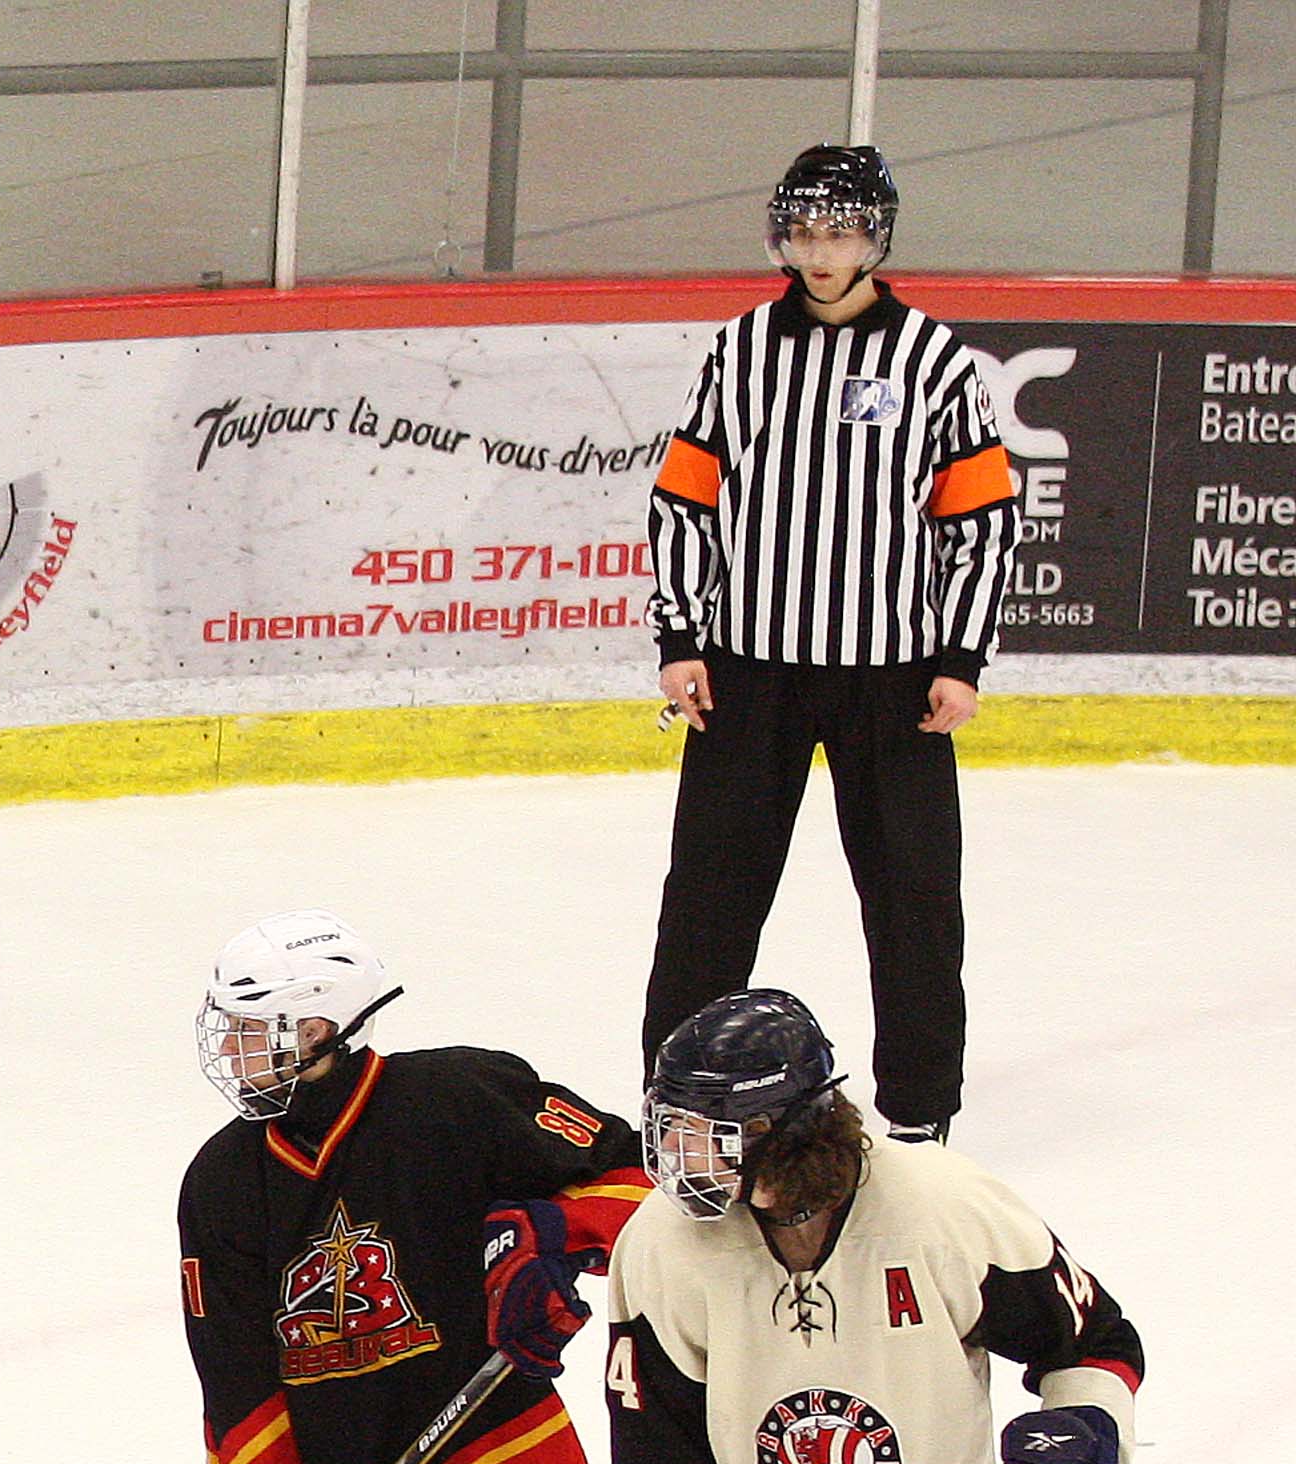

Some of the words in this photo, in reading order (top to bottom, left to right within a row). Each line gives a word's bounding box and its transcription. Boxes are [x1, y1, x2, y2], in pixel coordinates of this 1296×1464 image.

[194, 396, 339, 471] Toujours
[348, 397, 380, 438] là
[381, 416, 471, 454] pour
[480, 437, 550, 471] vous
[560, 430, 671, 476] diverti
[1196, 484, 1296, 525] Fibre
[352, 547, 453, 585] 450
[471, 543, 655, 582] 371-100
[202, 596, 646, 644] cinema7valleyfield.
[1000, 602, 1095, 626] 65-5663
[285, 932, 341, 951] EASTON
[534, 1096, 602, 1148] 81
[884, 1266, 924, 1328] A
[418, 1395, 468, 1453] BAUER
